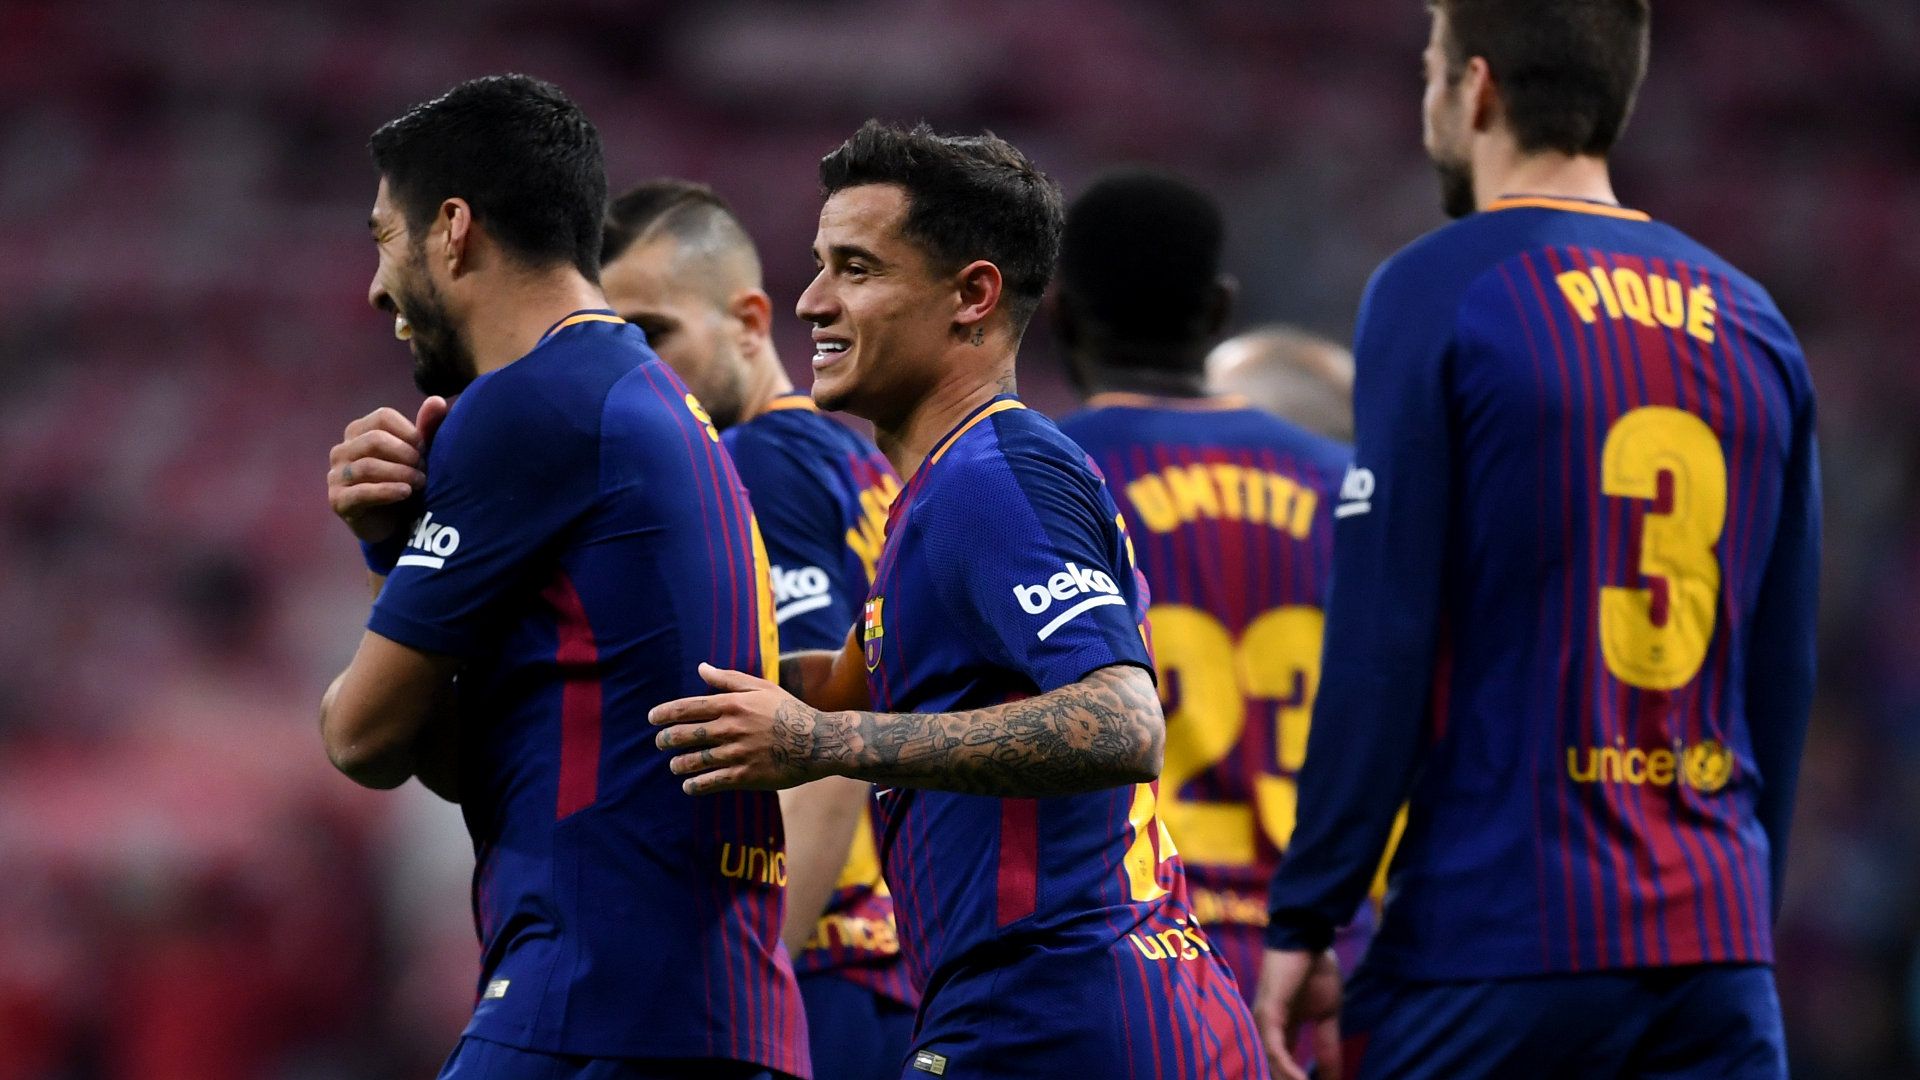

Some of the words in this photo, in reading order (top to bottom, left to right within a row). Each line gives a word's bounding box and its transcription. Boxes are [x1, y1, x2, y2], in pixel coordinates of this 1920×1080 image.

[1556, 265, 1717, 344] PIQUÉ
[1126, 462, 1318, 541] UMTITI
[1599, 405, 1728, 691] 3
[1012, 561, 1120, 615] beko
[1146, 602, 1326, 867] 23
[720, 836, 788, 887] unic
